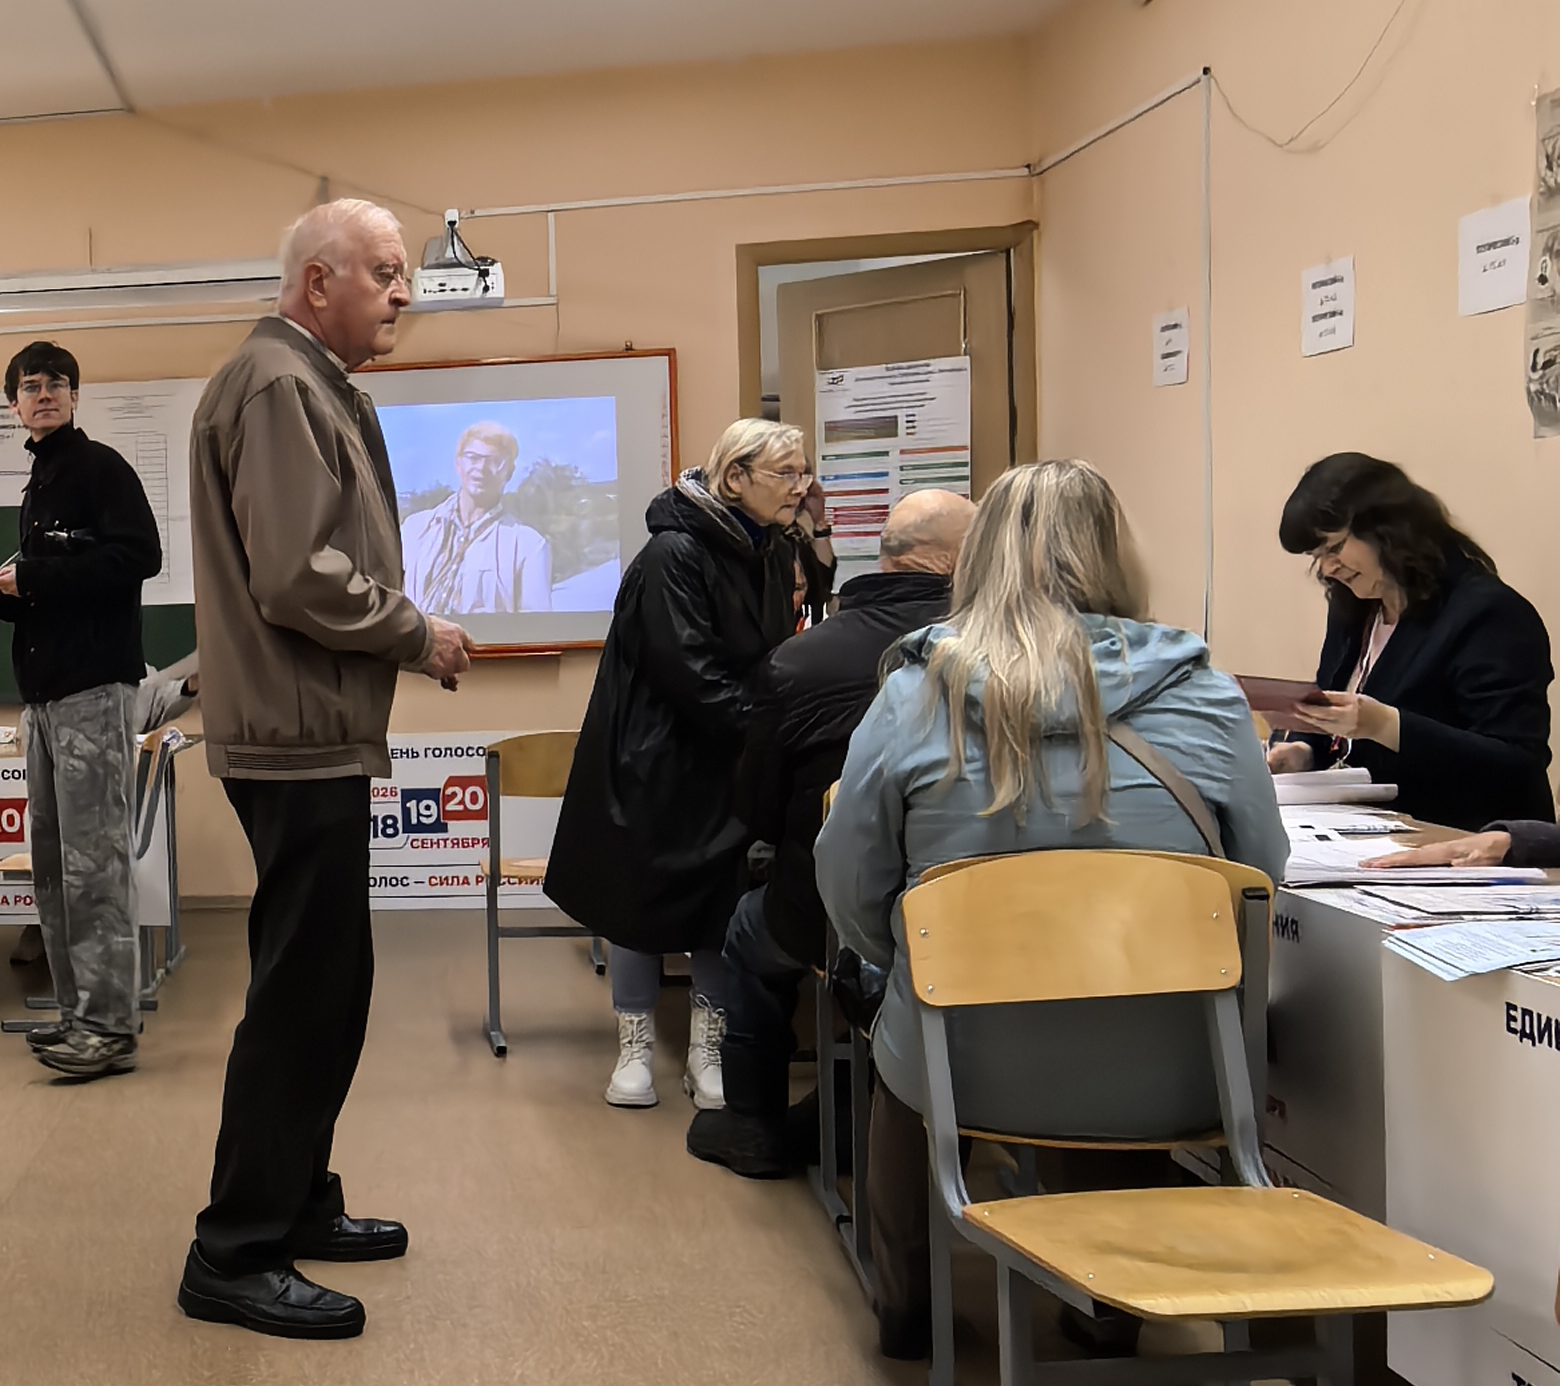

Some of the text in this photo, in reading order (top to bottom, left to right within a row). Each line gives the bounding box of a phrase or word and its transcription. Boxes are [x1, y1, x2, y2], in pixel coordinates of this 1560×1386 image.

[370, 786, 484, 839] 18 19 20
[410, 837, 490, 849] СЕНТЯБРЯ
[428, 875, 471, 887] СИЛА
